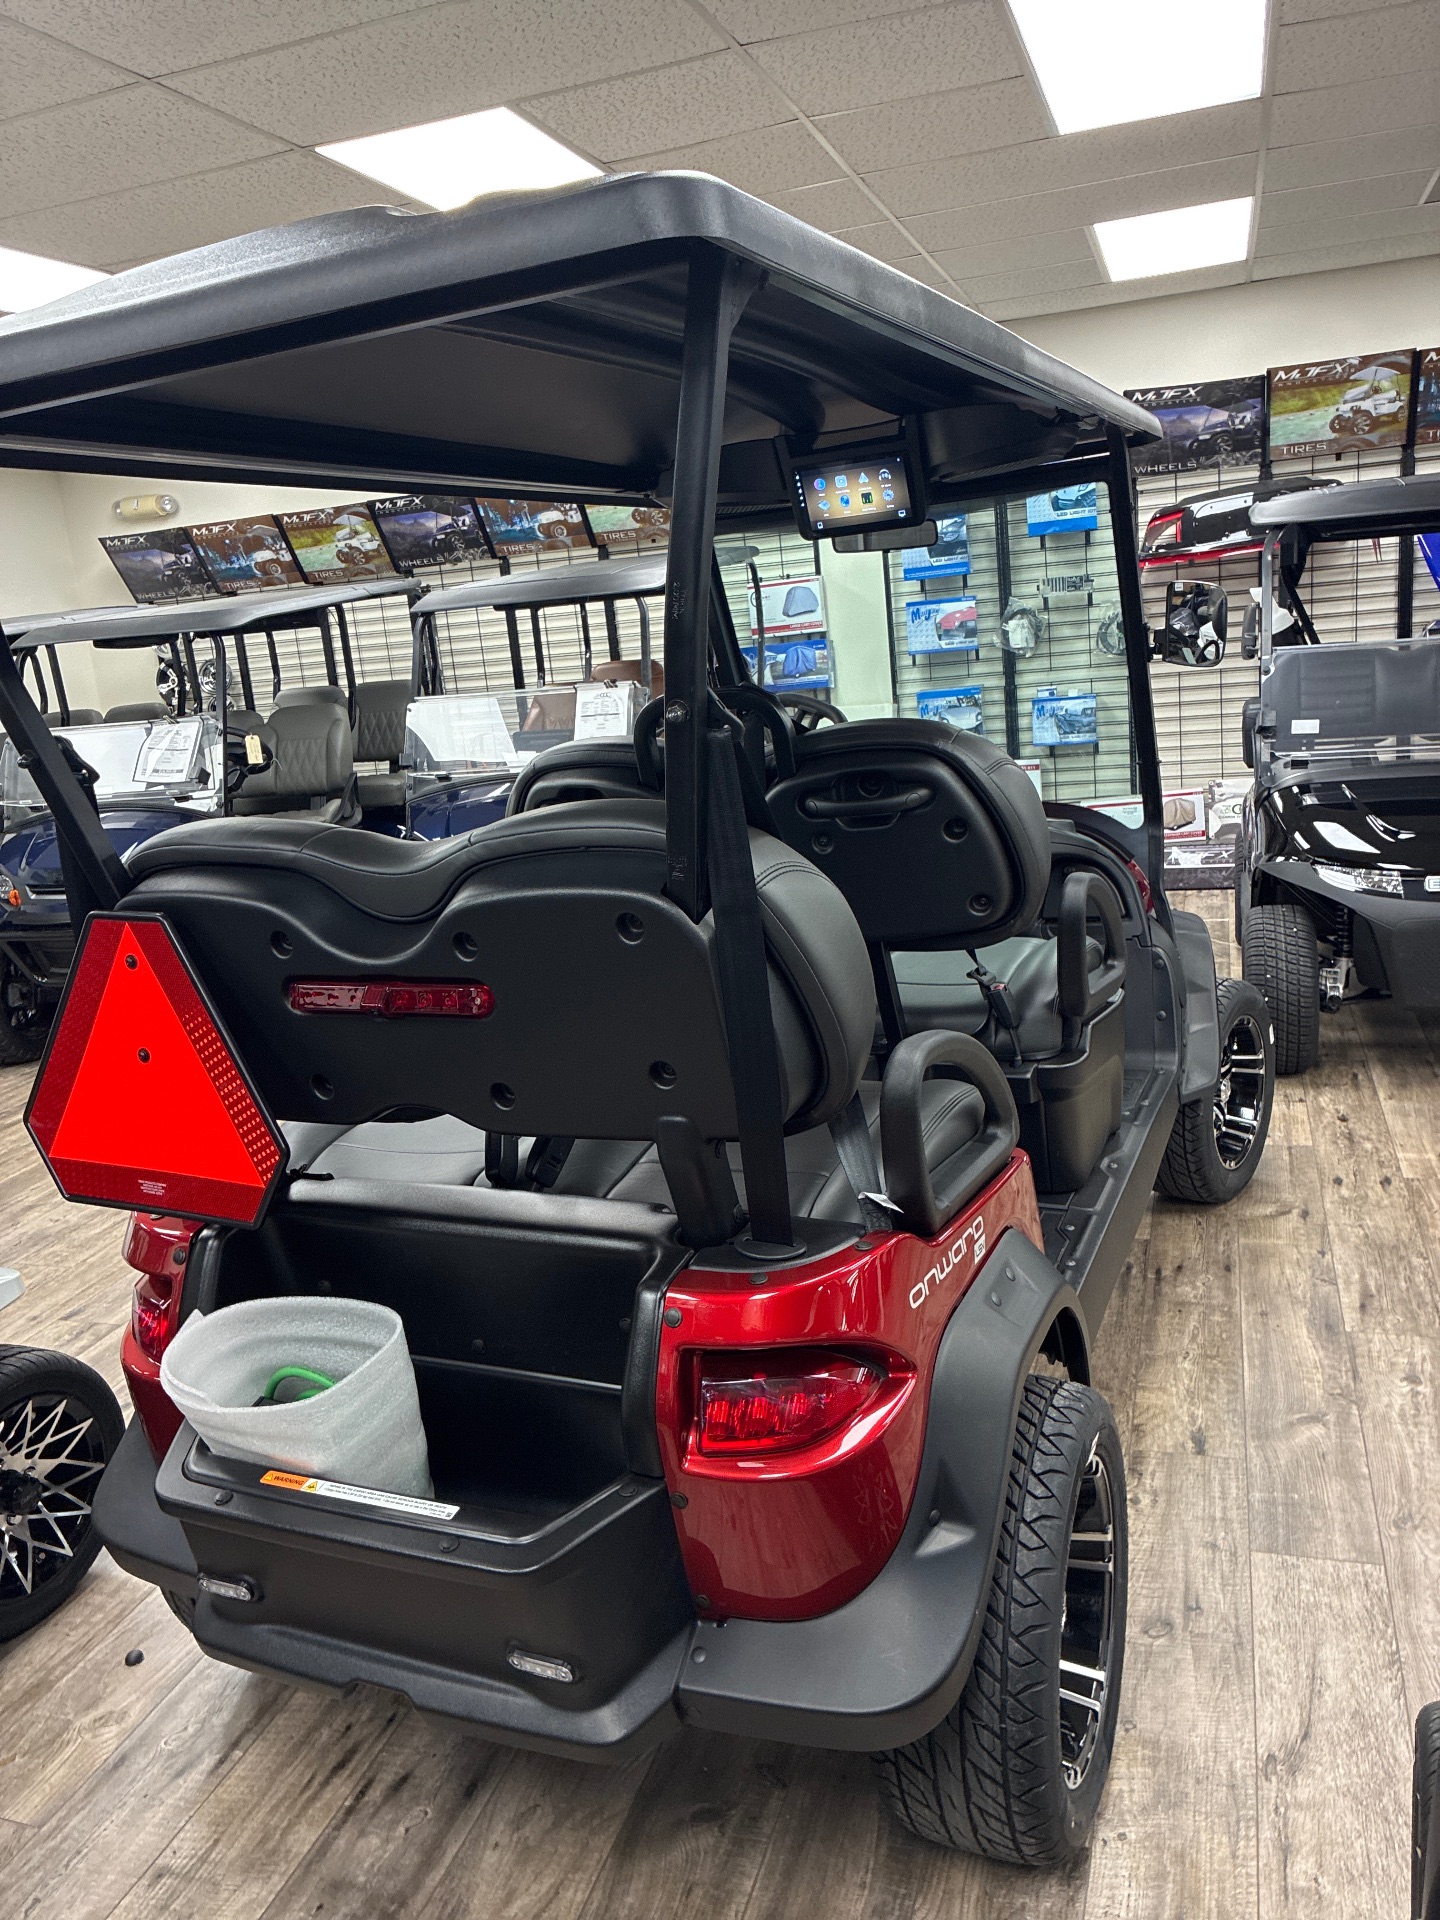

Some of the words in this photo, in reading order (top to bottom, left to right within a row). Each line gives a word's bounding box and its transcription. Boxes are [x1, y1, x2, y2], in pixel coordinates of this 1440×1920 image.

[1282, 442, 1327, 455] TIRES
[1134, 462, 1197, 474] WHEELS
[601, 531, 636, 541] TIRES
[501, 543, 534, 553] TIRES
[398, 555, 446, 568] WHEELS
[313, 570, 343, 579] TIRES
[225, 580, 254, 589] TIRES
[136, 590, 175, 600] WHEELS
[273, 1475, 304, 1486] WARNING
